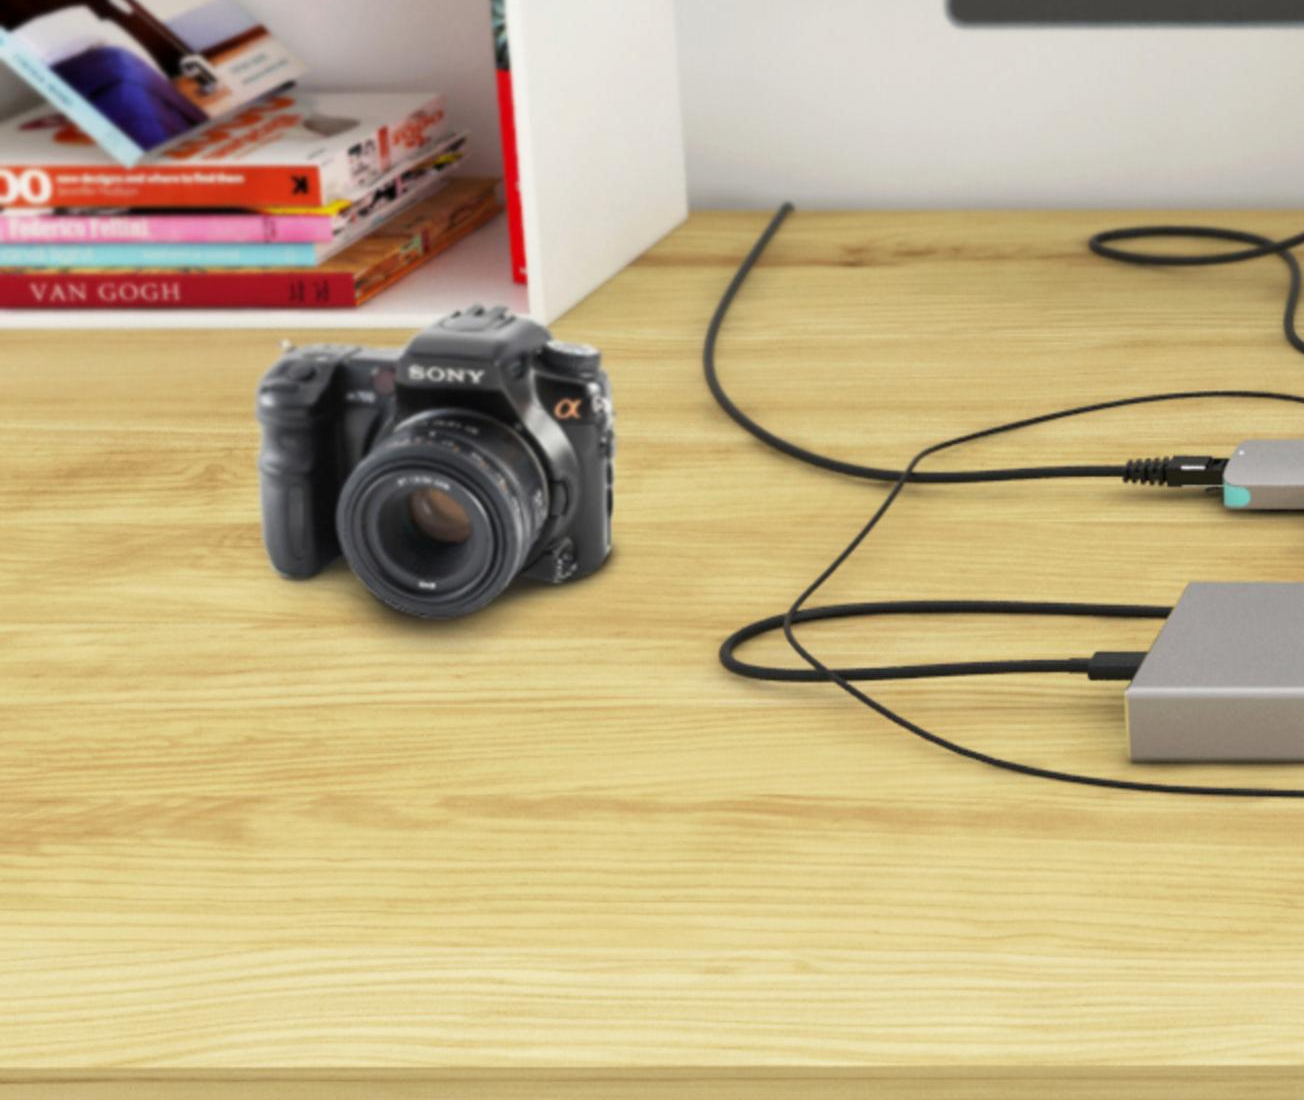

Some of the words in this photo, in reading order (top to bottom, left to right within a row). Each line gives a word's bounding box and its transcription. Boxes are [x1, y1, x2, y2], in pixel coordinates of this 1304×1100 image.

[30, 284, 86, 300] VAN
[97, 283, 180, 300] GOGH
[408, 364, 486, 384] SONY
